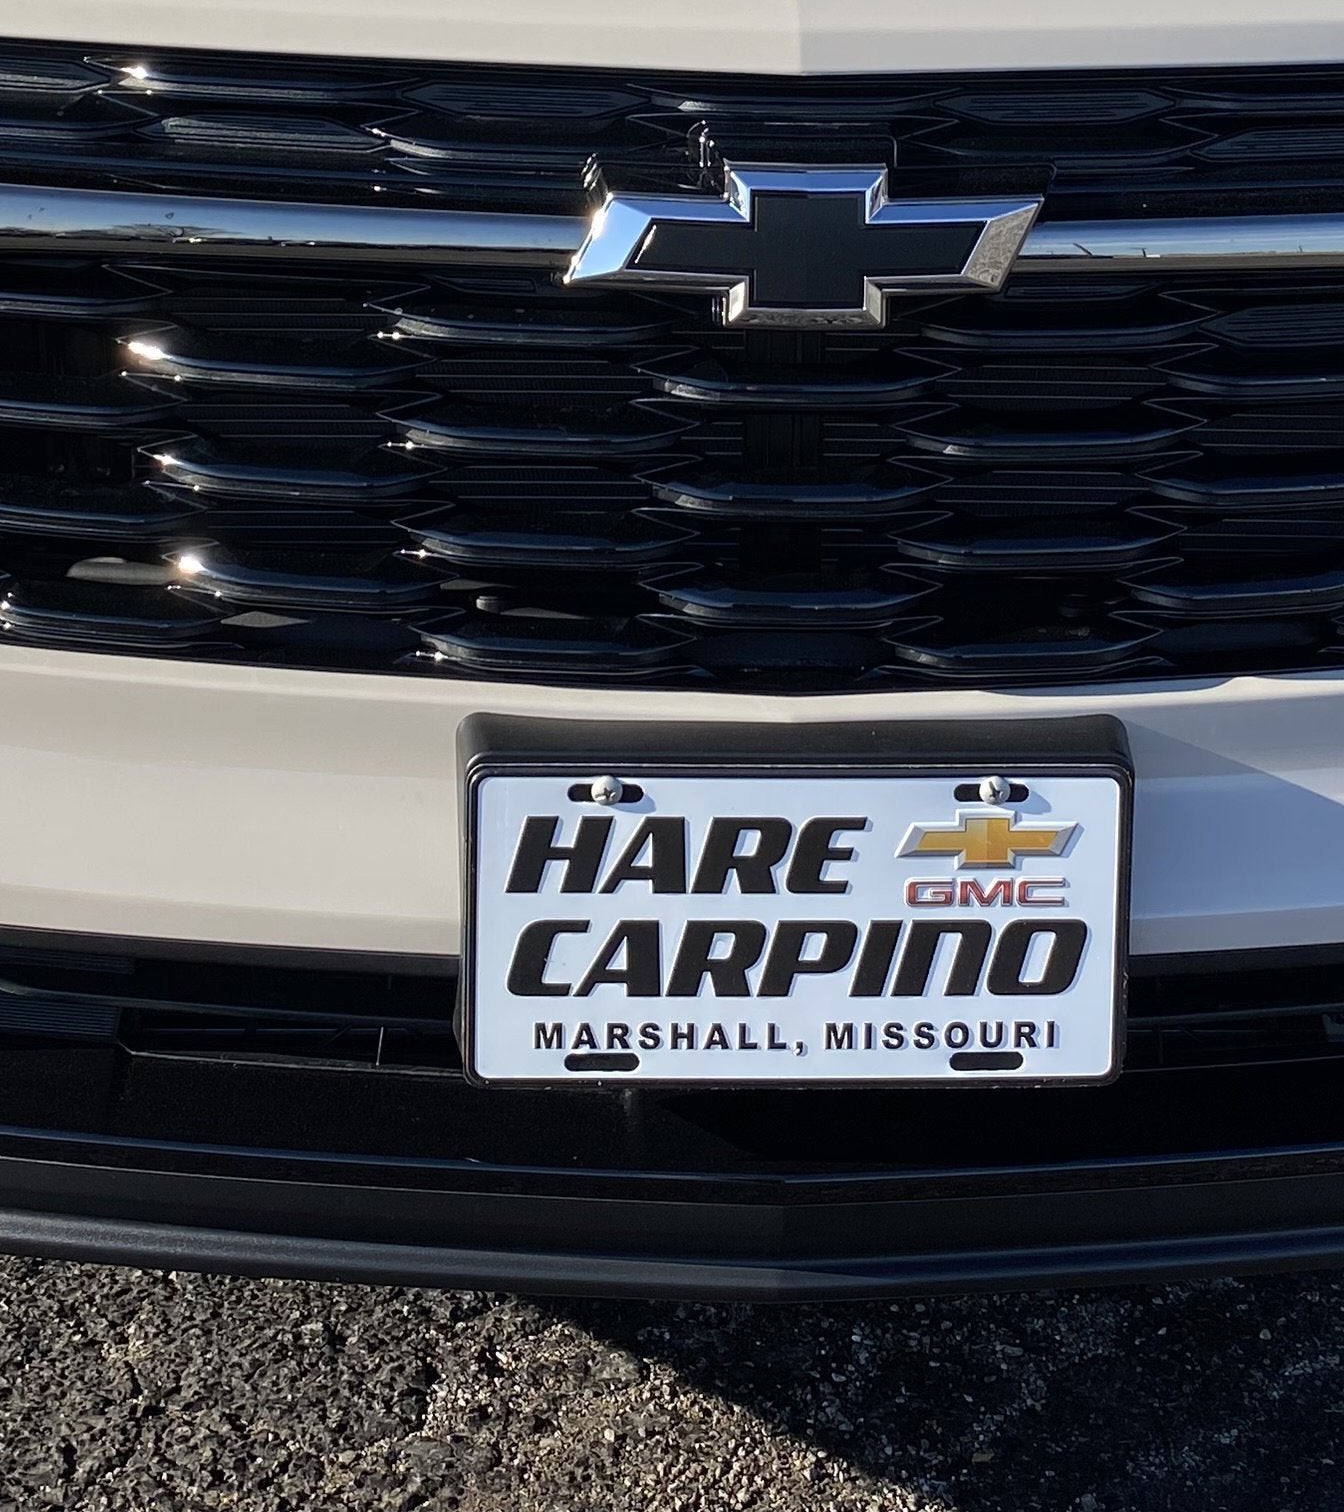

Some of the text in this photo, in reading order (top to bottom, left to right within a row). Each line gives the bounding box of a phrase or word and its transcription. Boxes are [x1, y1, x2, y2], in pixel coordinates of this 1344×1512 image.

[504, 815, 869, 895] HARE
[904, 876, 1067, 908] GMC
[506, 918, 1090, 998] CARPINO
[533, 1019, 1059, 1057] MARSHALL, MISSOURI
